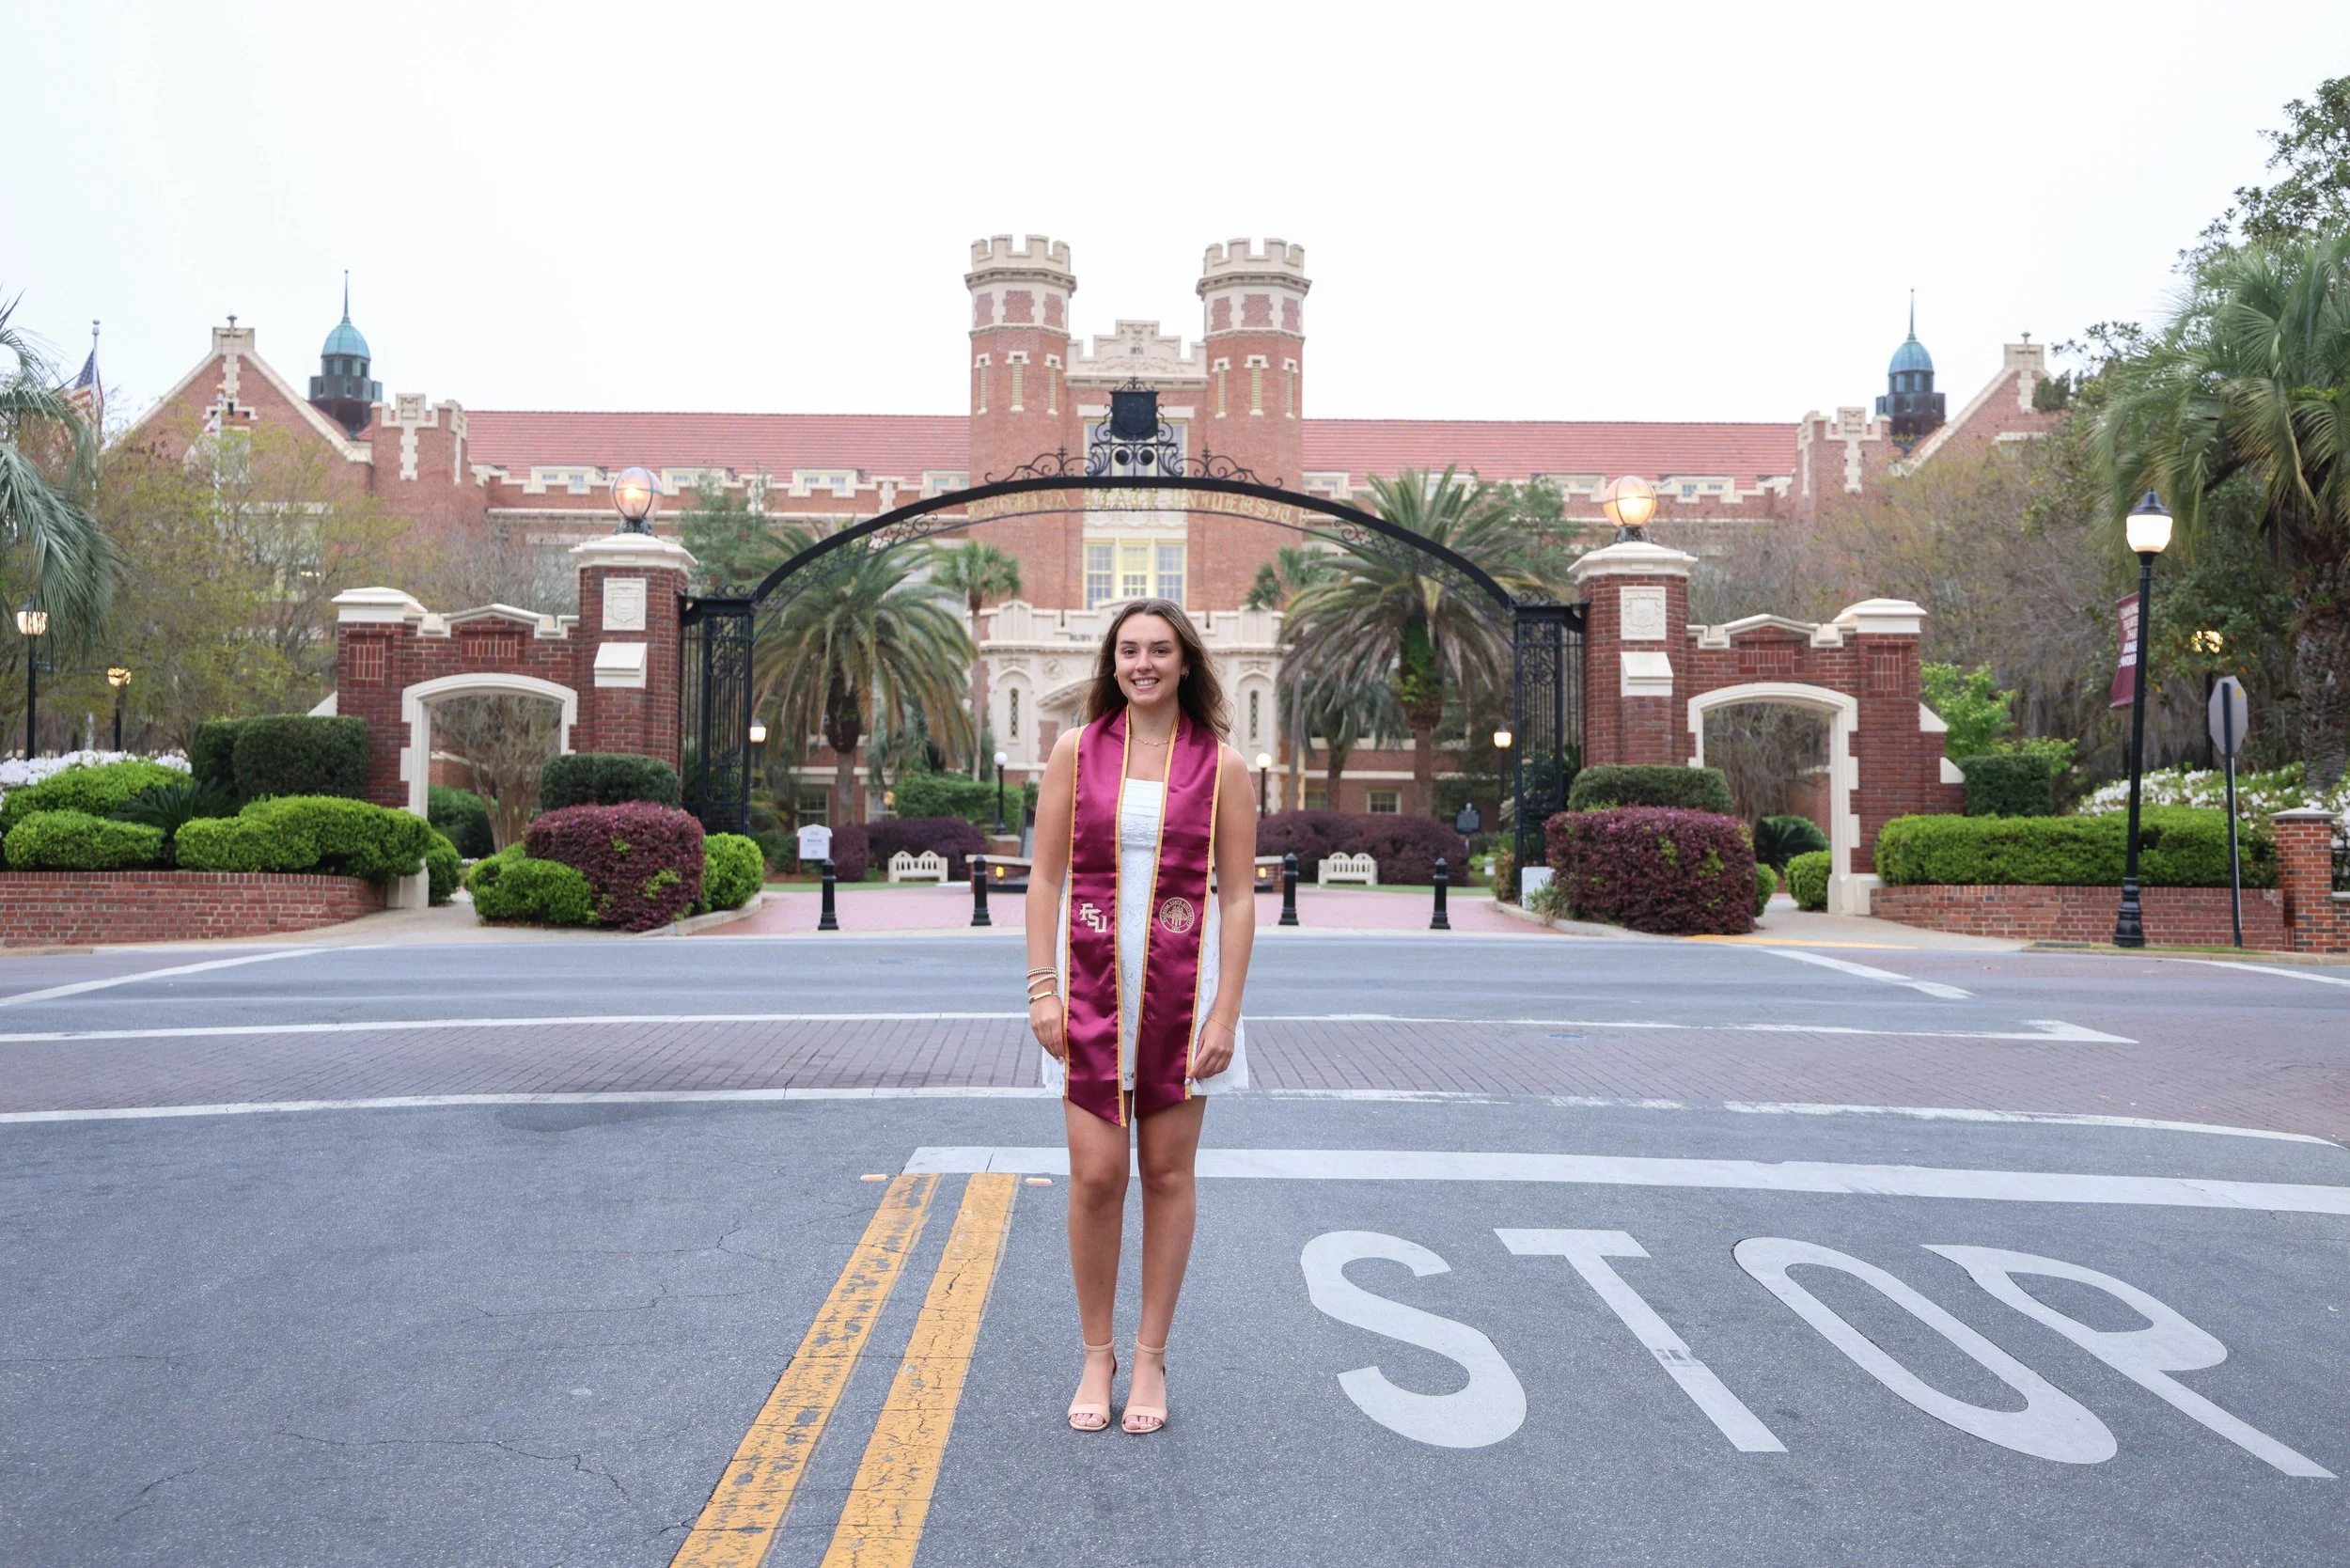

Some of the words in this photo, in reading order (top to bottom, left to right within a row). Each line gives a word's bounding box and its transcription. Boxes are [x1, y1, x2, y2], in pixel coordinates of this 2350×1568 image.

[965, 488, 1069, 518] FLORIDA
[1083, 488, 1158, 509] STATE
[1079, 902, 1107, 933] FSU
[1300, 1229, 2339, 1479] STOP
